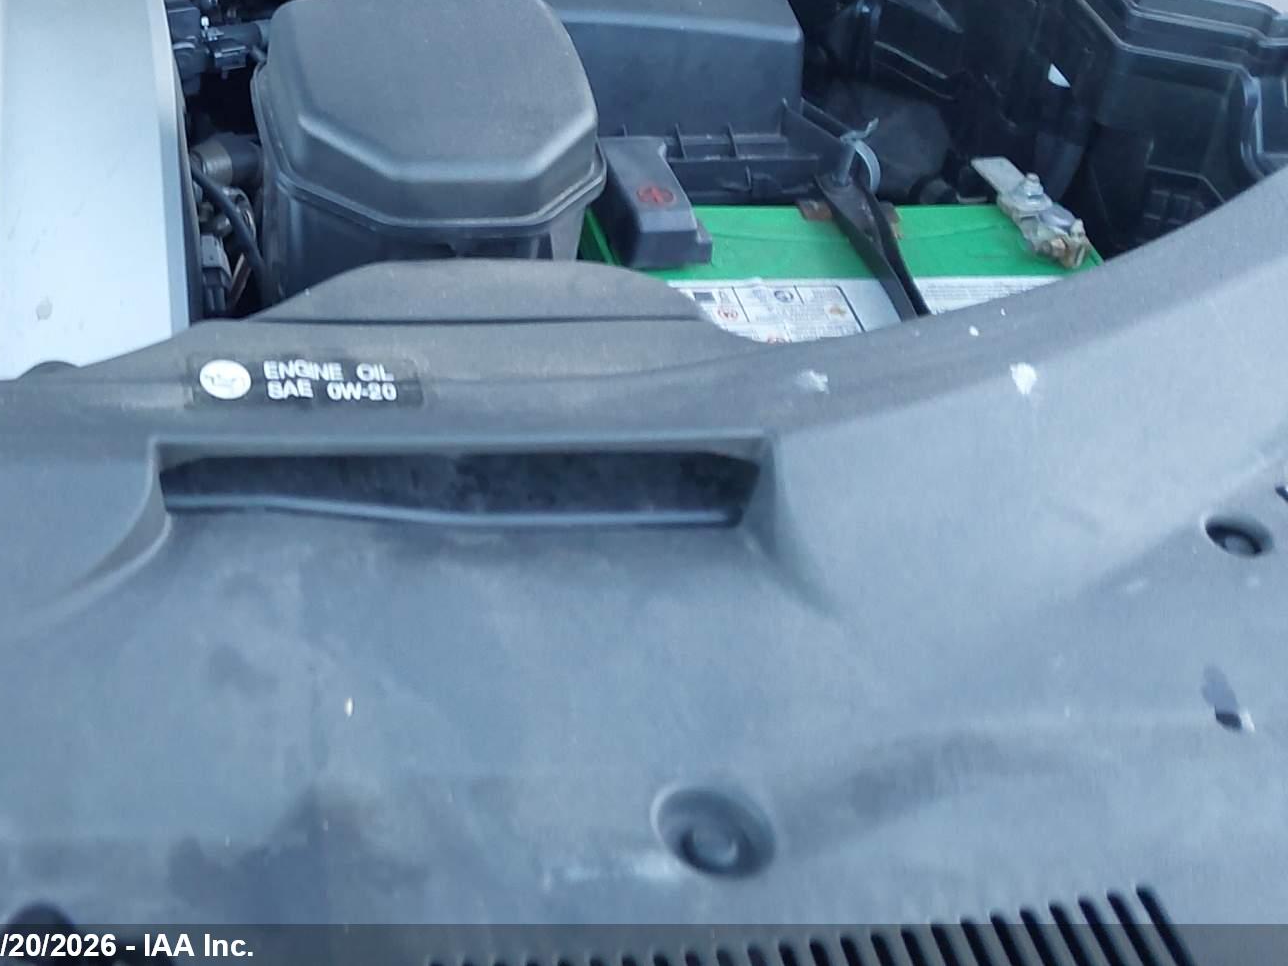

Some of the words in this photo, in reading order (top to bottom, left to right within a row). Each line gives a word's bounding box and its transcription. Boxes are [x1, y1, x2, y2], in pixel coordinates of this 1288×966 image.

[263, 359, 343, 380] ENGINE
[356, 362, 394, 381] OIL
[267, 378, 313, 399] SAE
[326, 381, 397, 400] 0W-20
